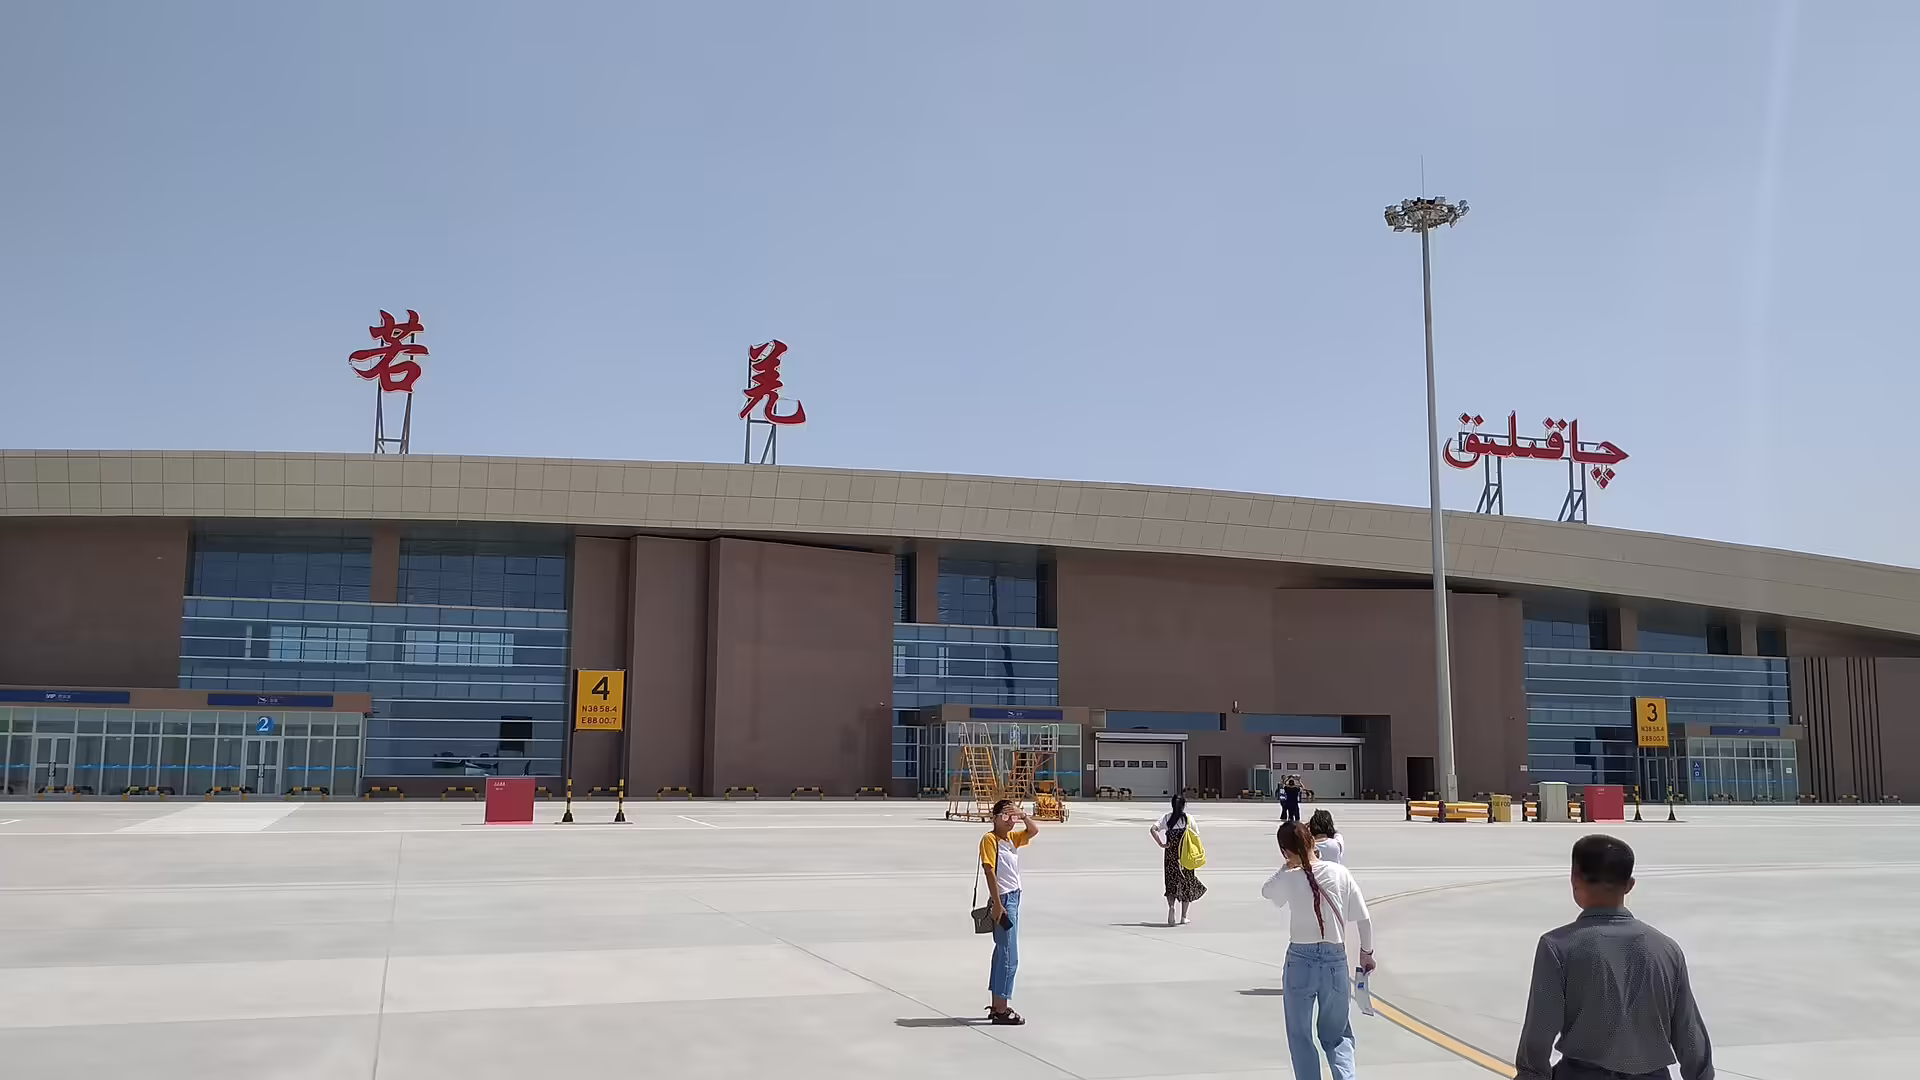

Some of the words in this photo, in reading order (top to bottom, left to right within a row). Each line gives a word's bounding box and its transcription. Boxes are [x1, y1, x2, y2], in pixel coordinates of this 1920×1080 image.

[591, 676, 610, 701] 4
[1647, 702, 1658, 722] 3
[258, 717, 268, 731] 2
